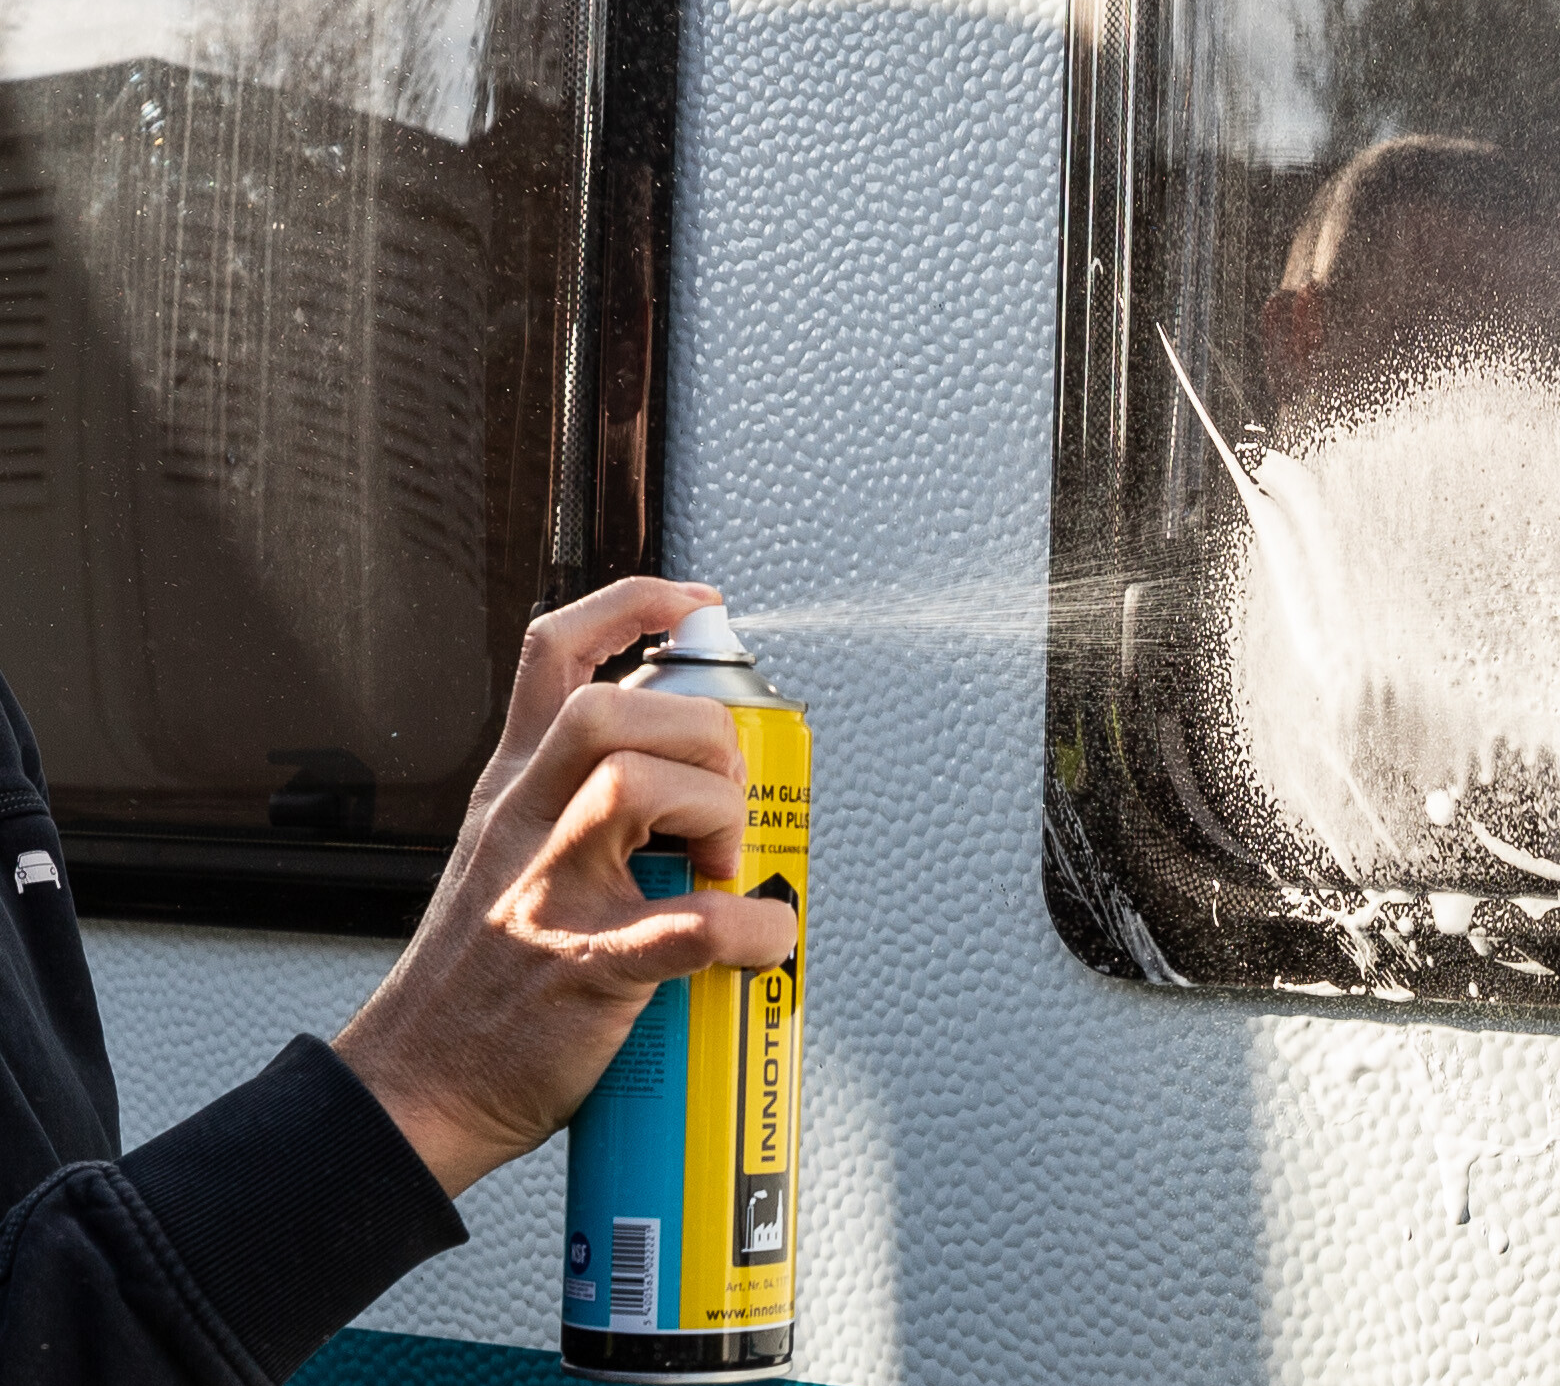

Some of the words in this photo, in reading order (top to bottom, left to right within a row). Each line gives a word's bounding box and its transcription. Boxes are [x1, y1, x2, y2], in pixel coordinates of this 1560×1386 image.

[743, 784, 774, 802] AM
[745, 810, 782, 828] EAN
[761, 975, 782, 1163] INNOTEC
